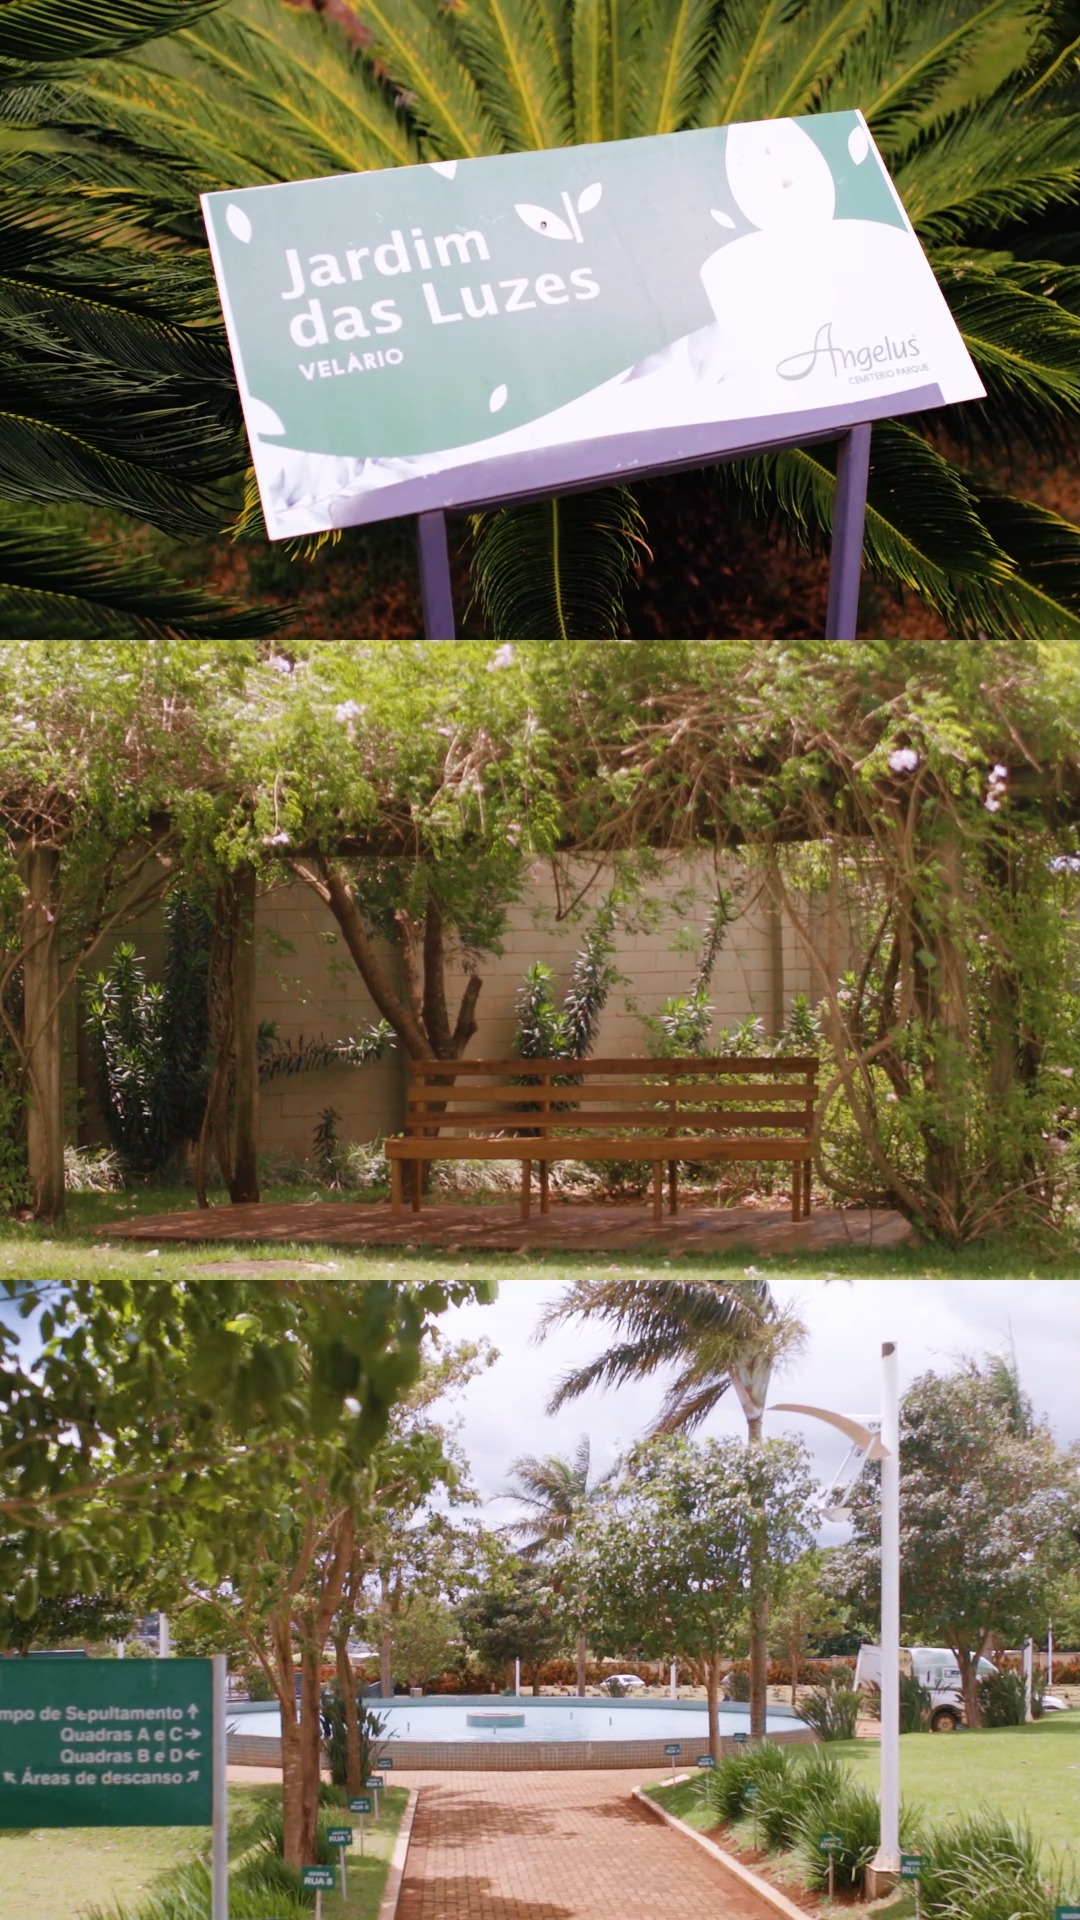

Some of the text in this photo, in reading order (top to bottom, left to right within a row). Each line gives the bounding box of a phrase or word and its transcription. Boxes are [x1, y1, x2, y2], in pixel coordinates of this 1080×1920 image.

[280, 227, 491, 300] Jardim
[289, 266, 601, 348] das Luzes
[775, 321, 921, 382] Angelus
[298, 348, 405, 381] VELÁRIO
[895, 362, 930, 377] PARQUE
[39, 1705, 61, 1721] de
[66, 1705, 184, 1724] Sepultamento
[60, 1726, 184, 1742] Quadras A e C
[60, 1748, 183, 1764] Quadras B e D
[21, 1766, 183, 1785] Áreas de descanso
[328, 1835, 346, 1843] RUA
[303, 1876, 325, 1886] RUA
